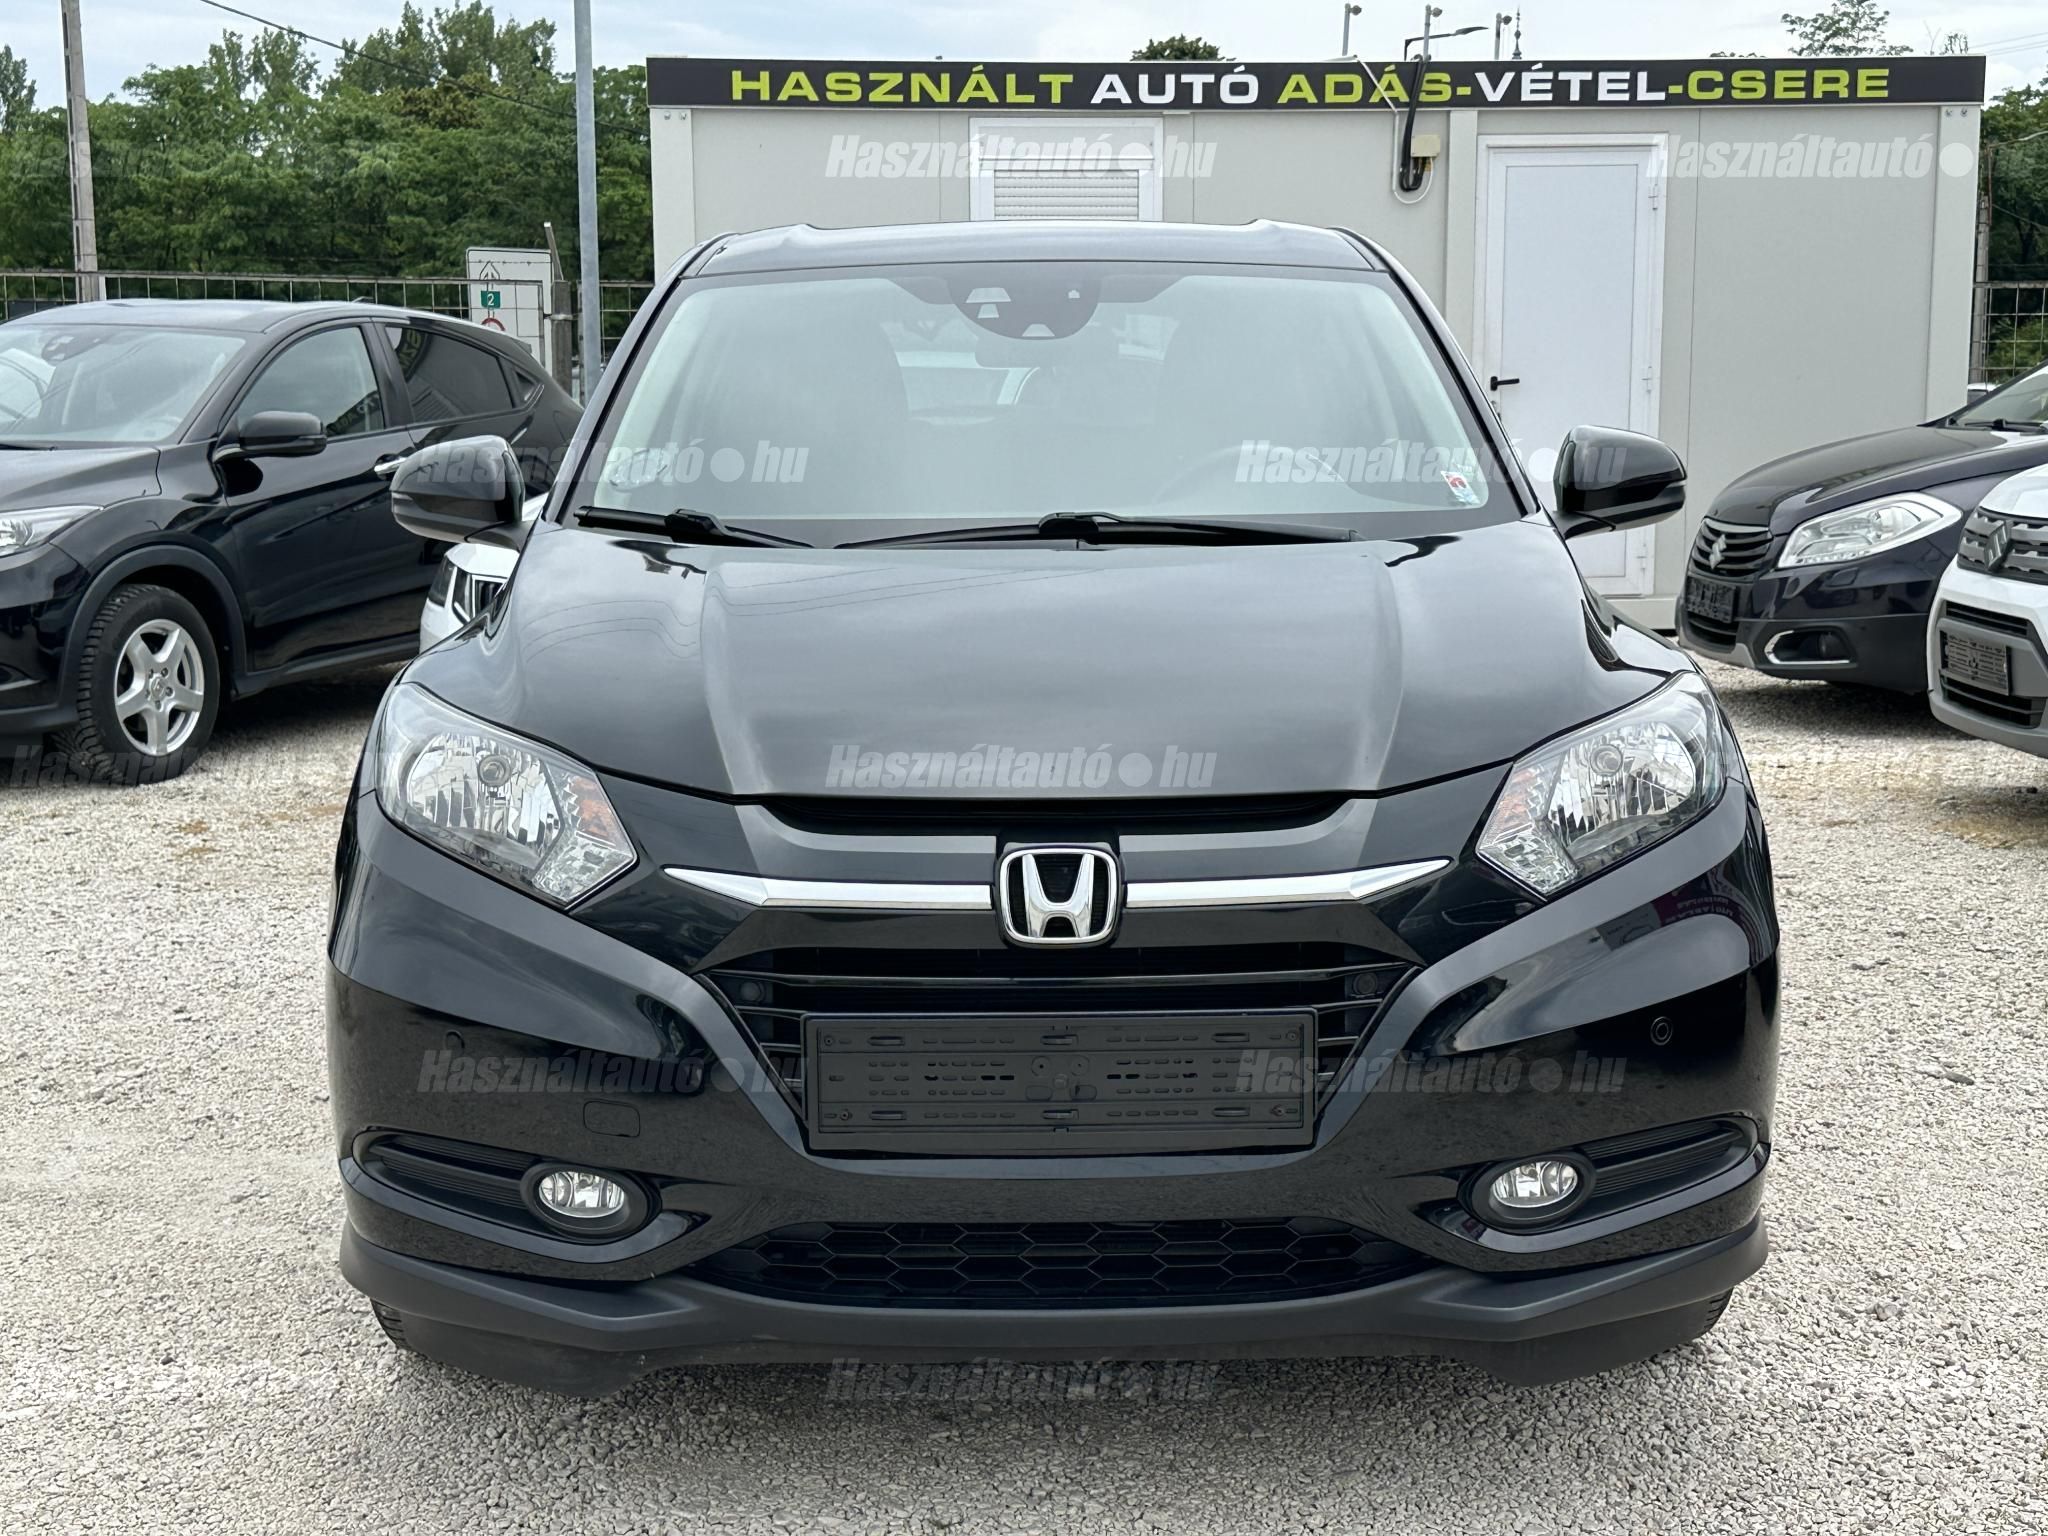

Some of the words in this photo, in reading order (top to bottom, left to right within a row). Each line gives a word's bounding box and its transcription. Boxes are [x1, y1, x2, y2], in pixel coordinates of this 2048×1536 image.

[731, 65, 1074, 103] HASZNÁLT
[1090, 65, 1259, 104] AUTÓ
[487, 293, 495, 306] 2
